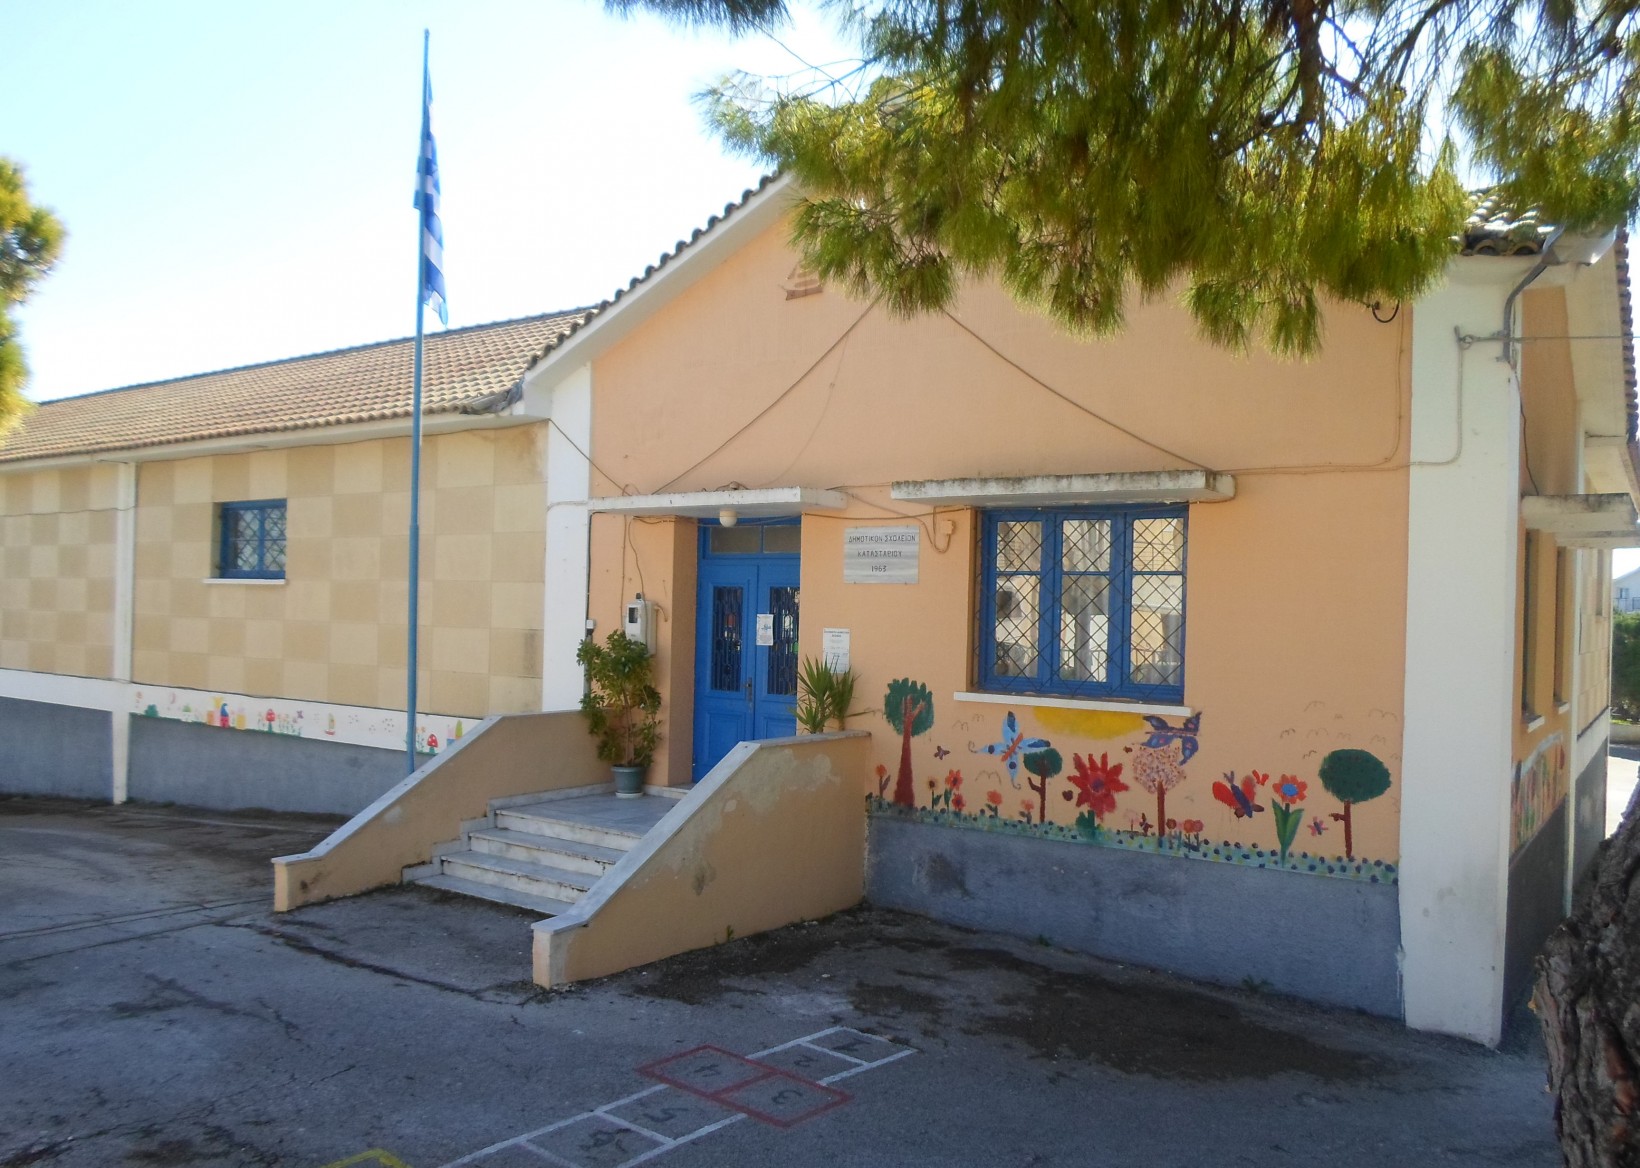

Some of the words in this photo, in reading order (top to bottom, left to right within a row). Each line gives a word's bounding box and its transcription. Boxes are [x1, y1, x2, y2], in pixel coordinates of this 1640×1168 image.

[848, 535, 883, 543] ΔΗΜΟΤΙΚΟΝ
[857, 550, 902, 558] ΚΑΤΑΣΤΑΡΙΟΥ
[871, 565, 887, 573] 1963
[770, 1089, 803, 1105] 3
